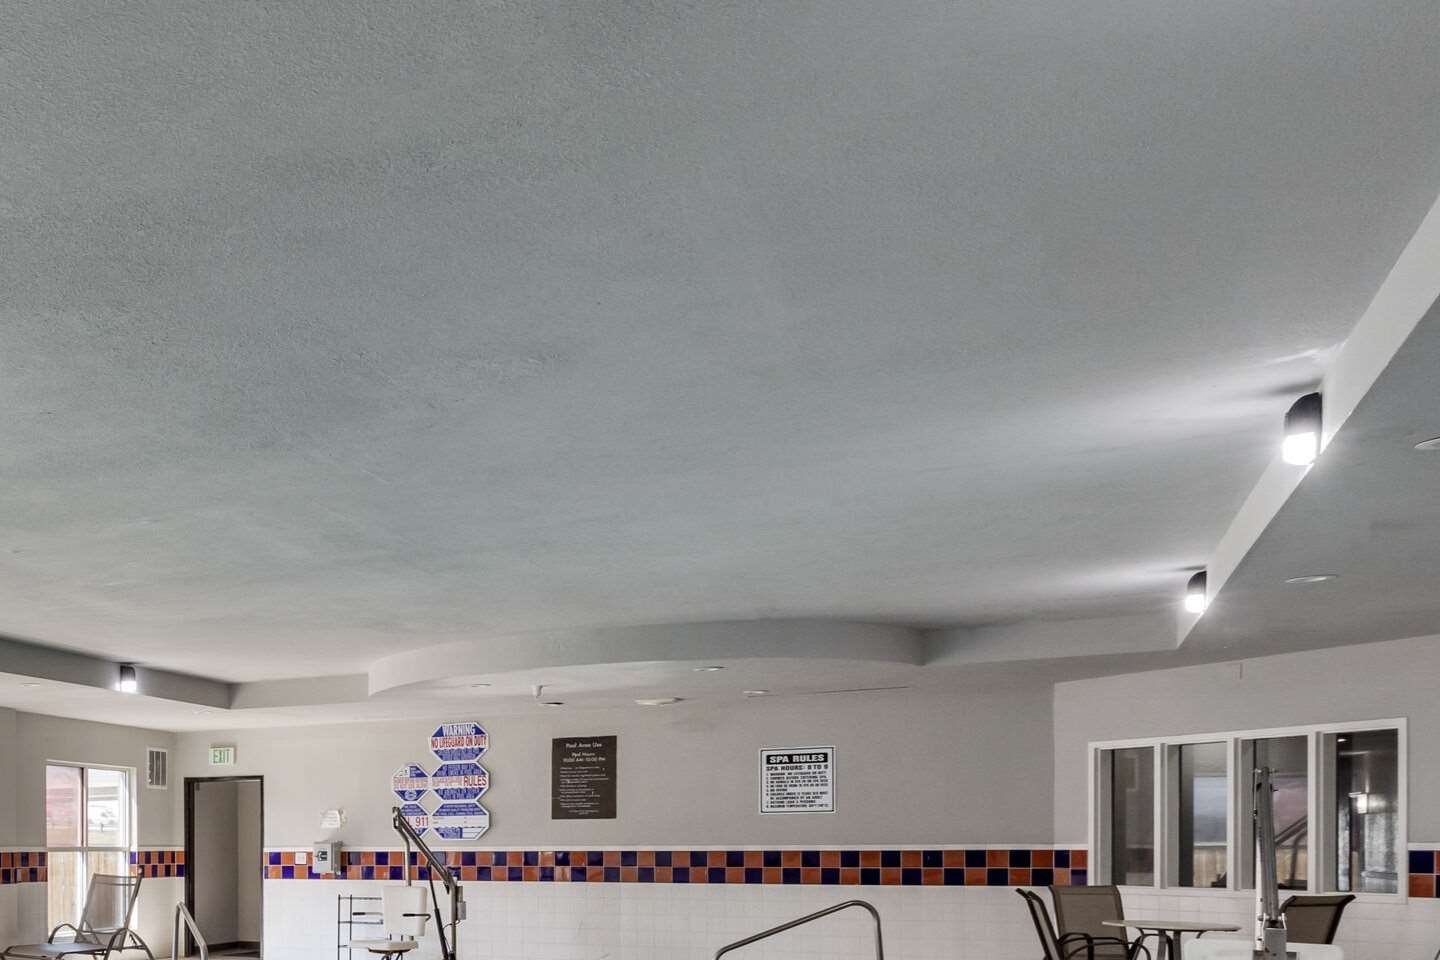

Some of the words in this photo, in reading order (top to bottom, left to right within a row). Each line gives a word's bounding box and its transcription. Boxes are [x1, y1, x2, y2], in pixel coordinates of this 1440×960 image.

[442, 724, 475, 737] WARNING
[431, 737, 438, 748] NO
[439, 737, 464, 748] LIFEGUARD
[466, 737, 473, 747] ON
[474, 736, 487, 746] DUTY
[213, 749, 232, 763] EXIT
[769, 755, 789, 763] SPA
[792, 754, 825, 763] RULES
[464, 776, 487, 787] RULES
[415, 817, 429, 827] 911
